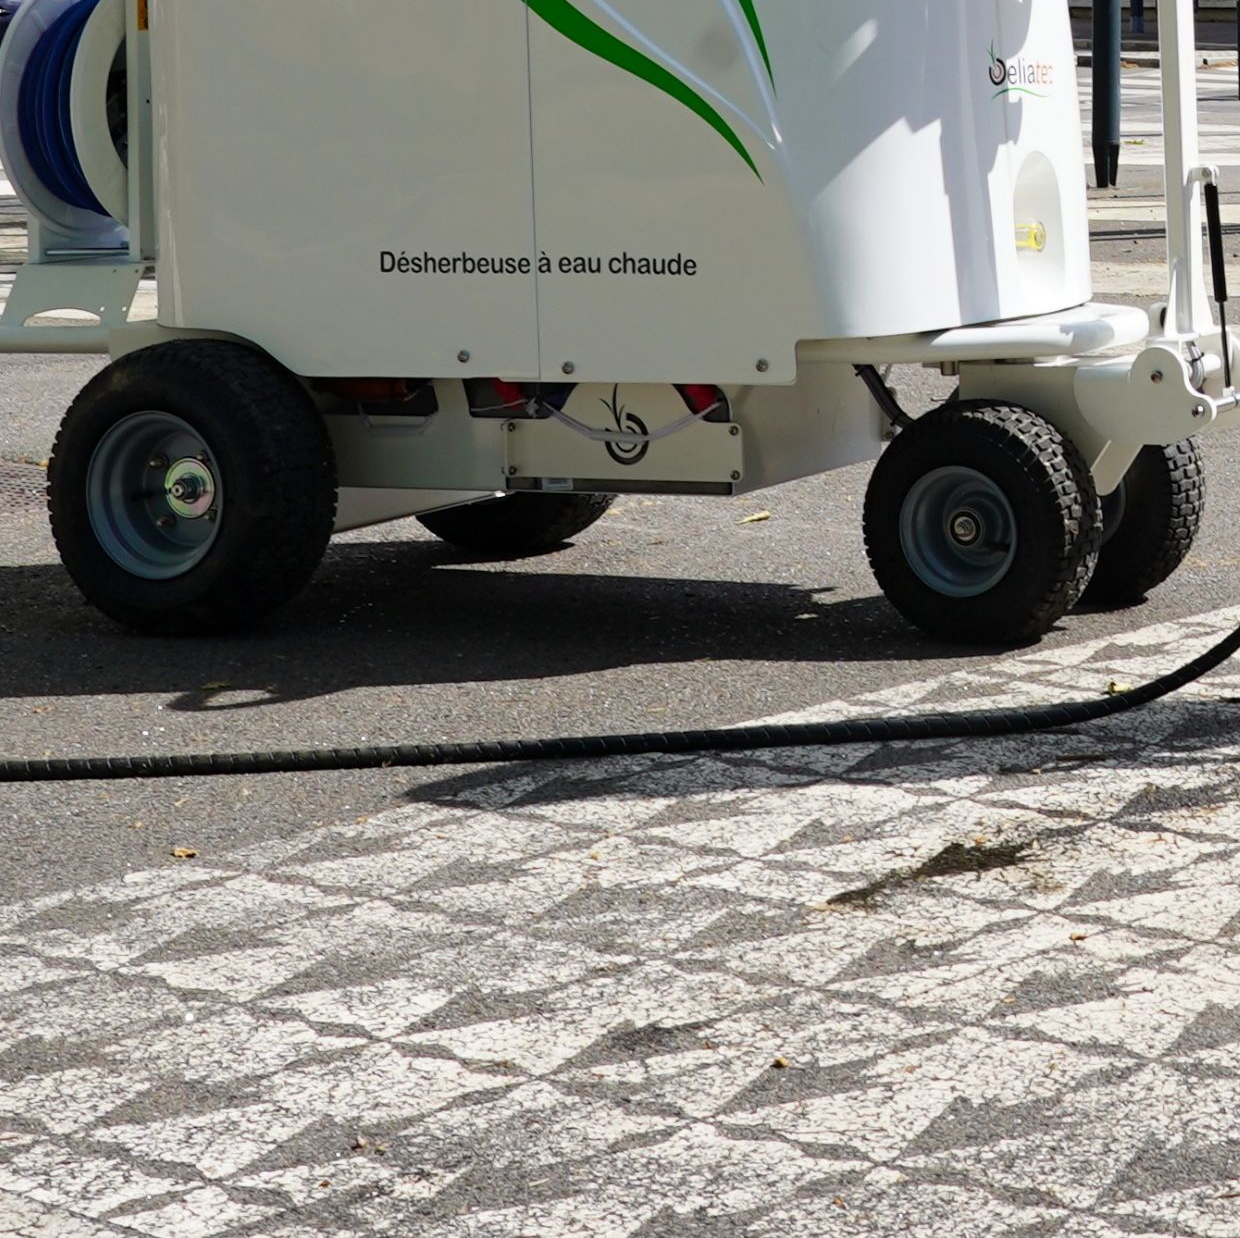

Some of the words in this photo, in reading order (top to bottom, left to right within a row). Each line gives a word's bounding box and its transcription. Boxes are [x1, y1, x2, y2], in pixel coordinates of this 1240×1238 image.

[379, 250, 532, 275] Désherbeuse
[537, 250, 552, 274] à
[558, 256, 601, 274] eau
[608, 251, 698, 276] chaude
